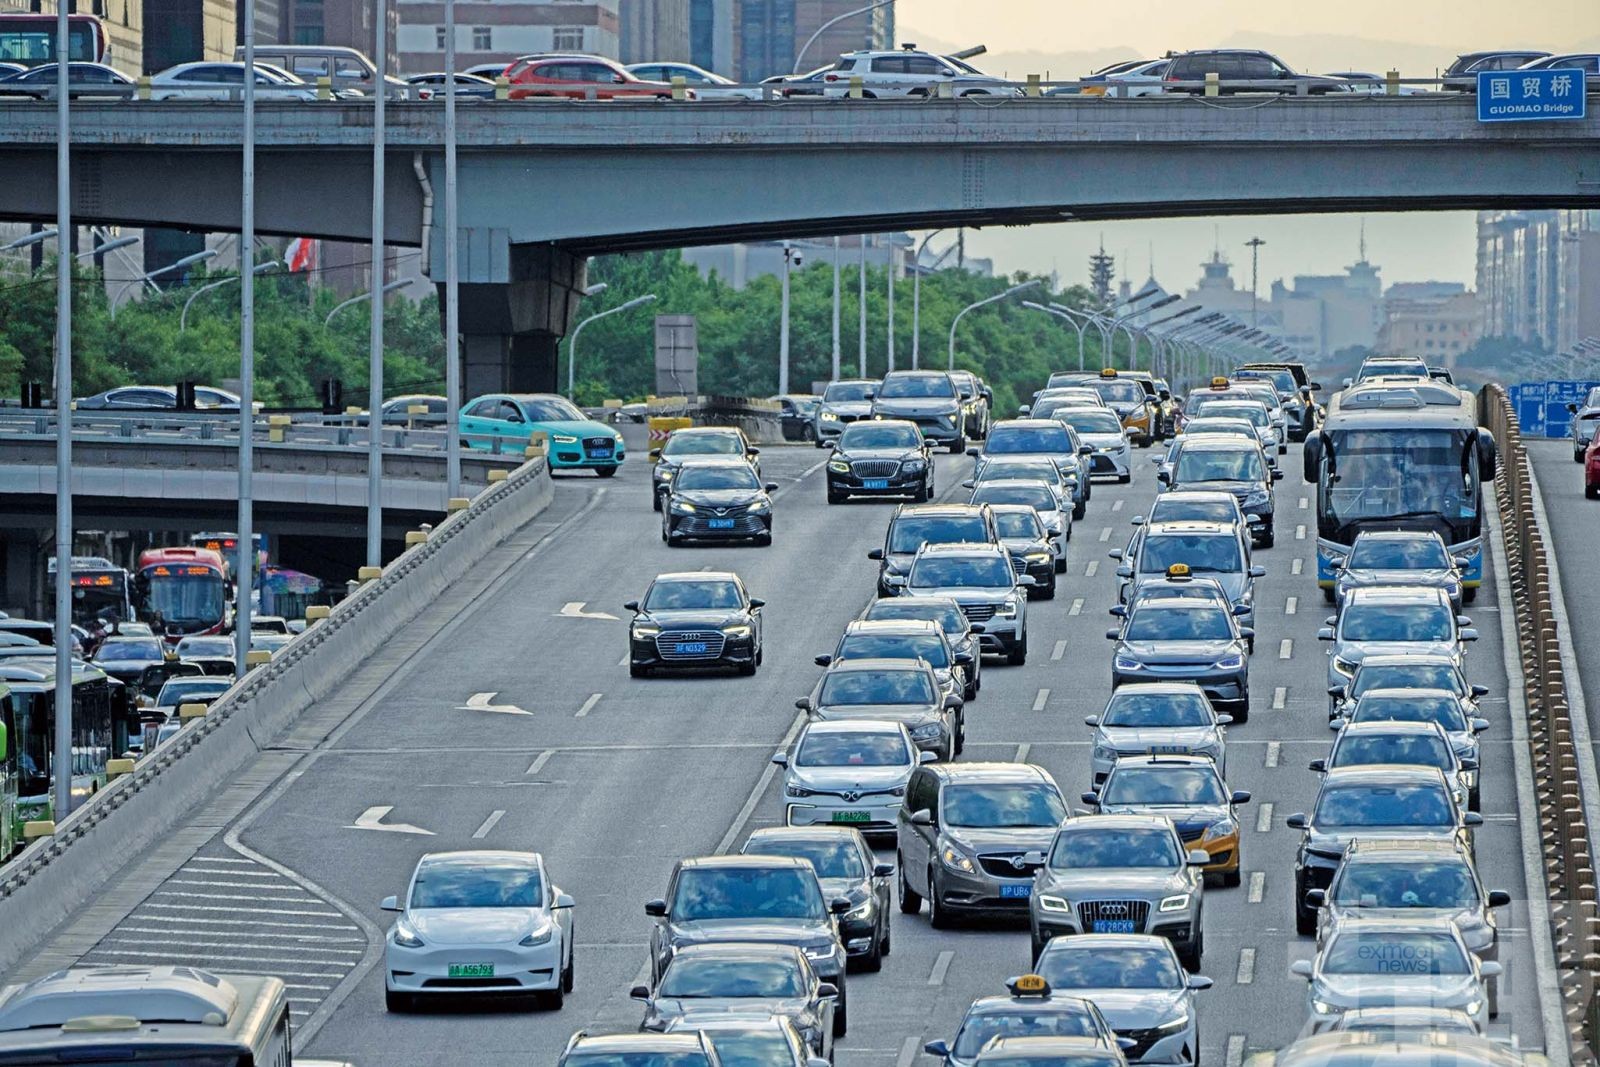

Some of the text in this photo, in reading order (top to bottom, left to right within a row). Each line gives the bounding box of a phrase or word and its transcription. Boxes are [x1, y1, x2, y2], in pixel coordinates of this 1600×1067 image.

[1490, 75, 1573, 99] 国贸桥
[1489, 104, 1574, 114] GUOMAO Bridge
